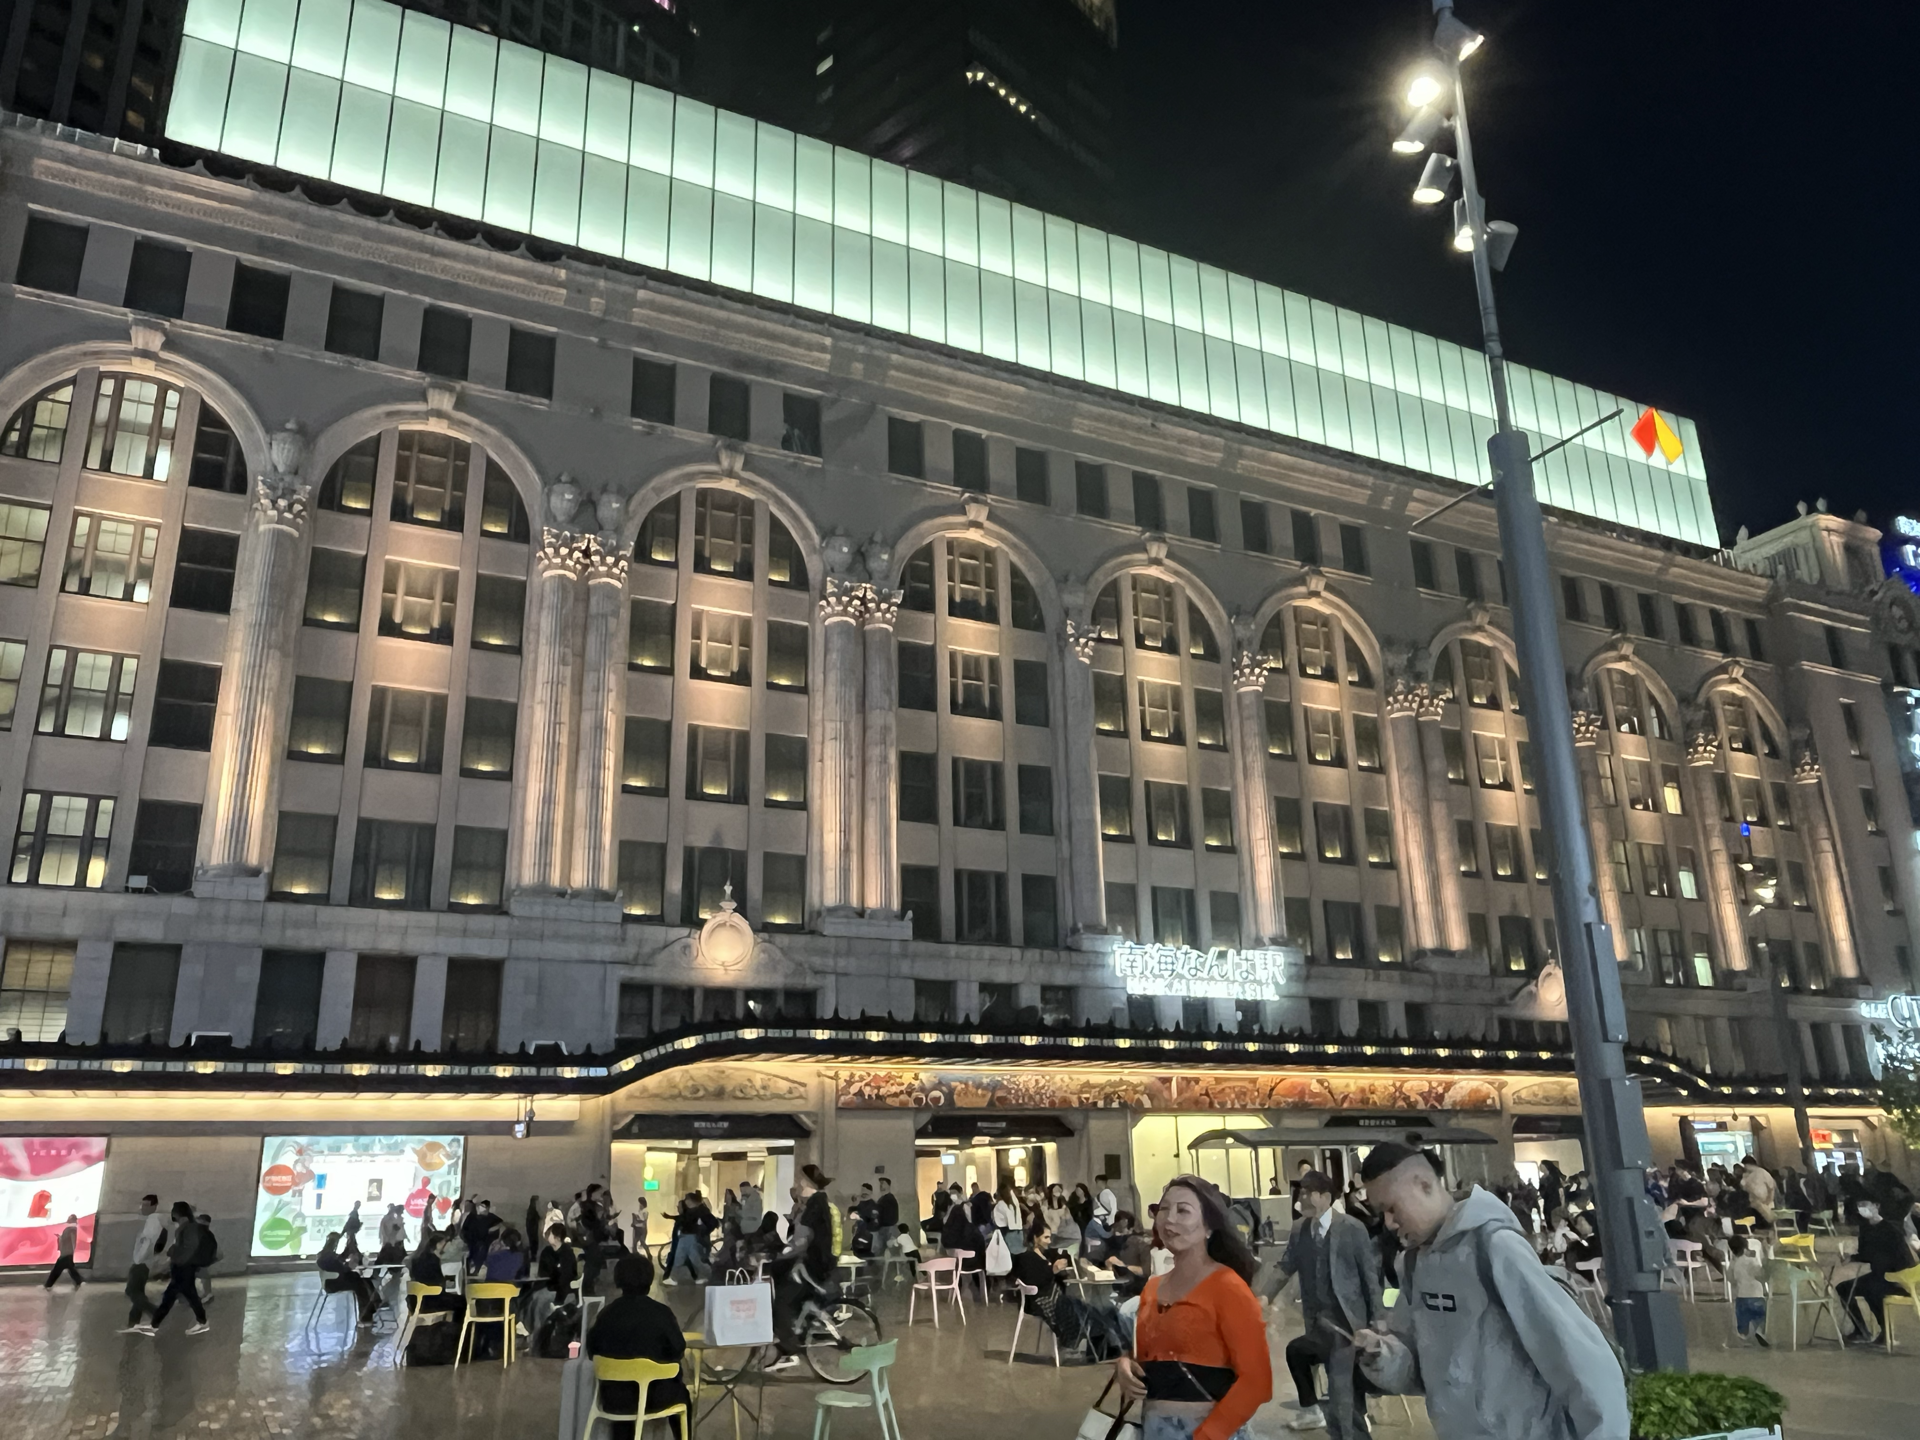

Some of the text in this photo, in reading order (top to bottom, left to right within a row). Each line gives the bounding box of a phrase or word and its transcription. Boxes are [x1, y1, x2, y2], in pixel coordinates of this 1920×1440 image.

[1113, 942, 1286, 984] 南海なんば駅
